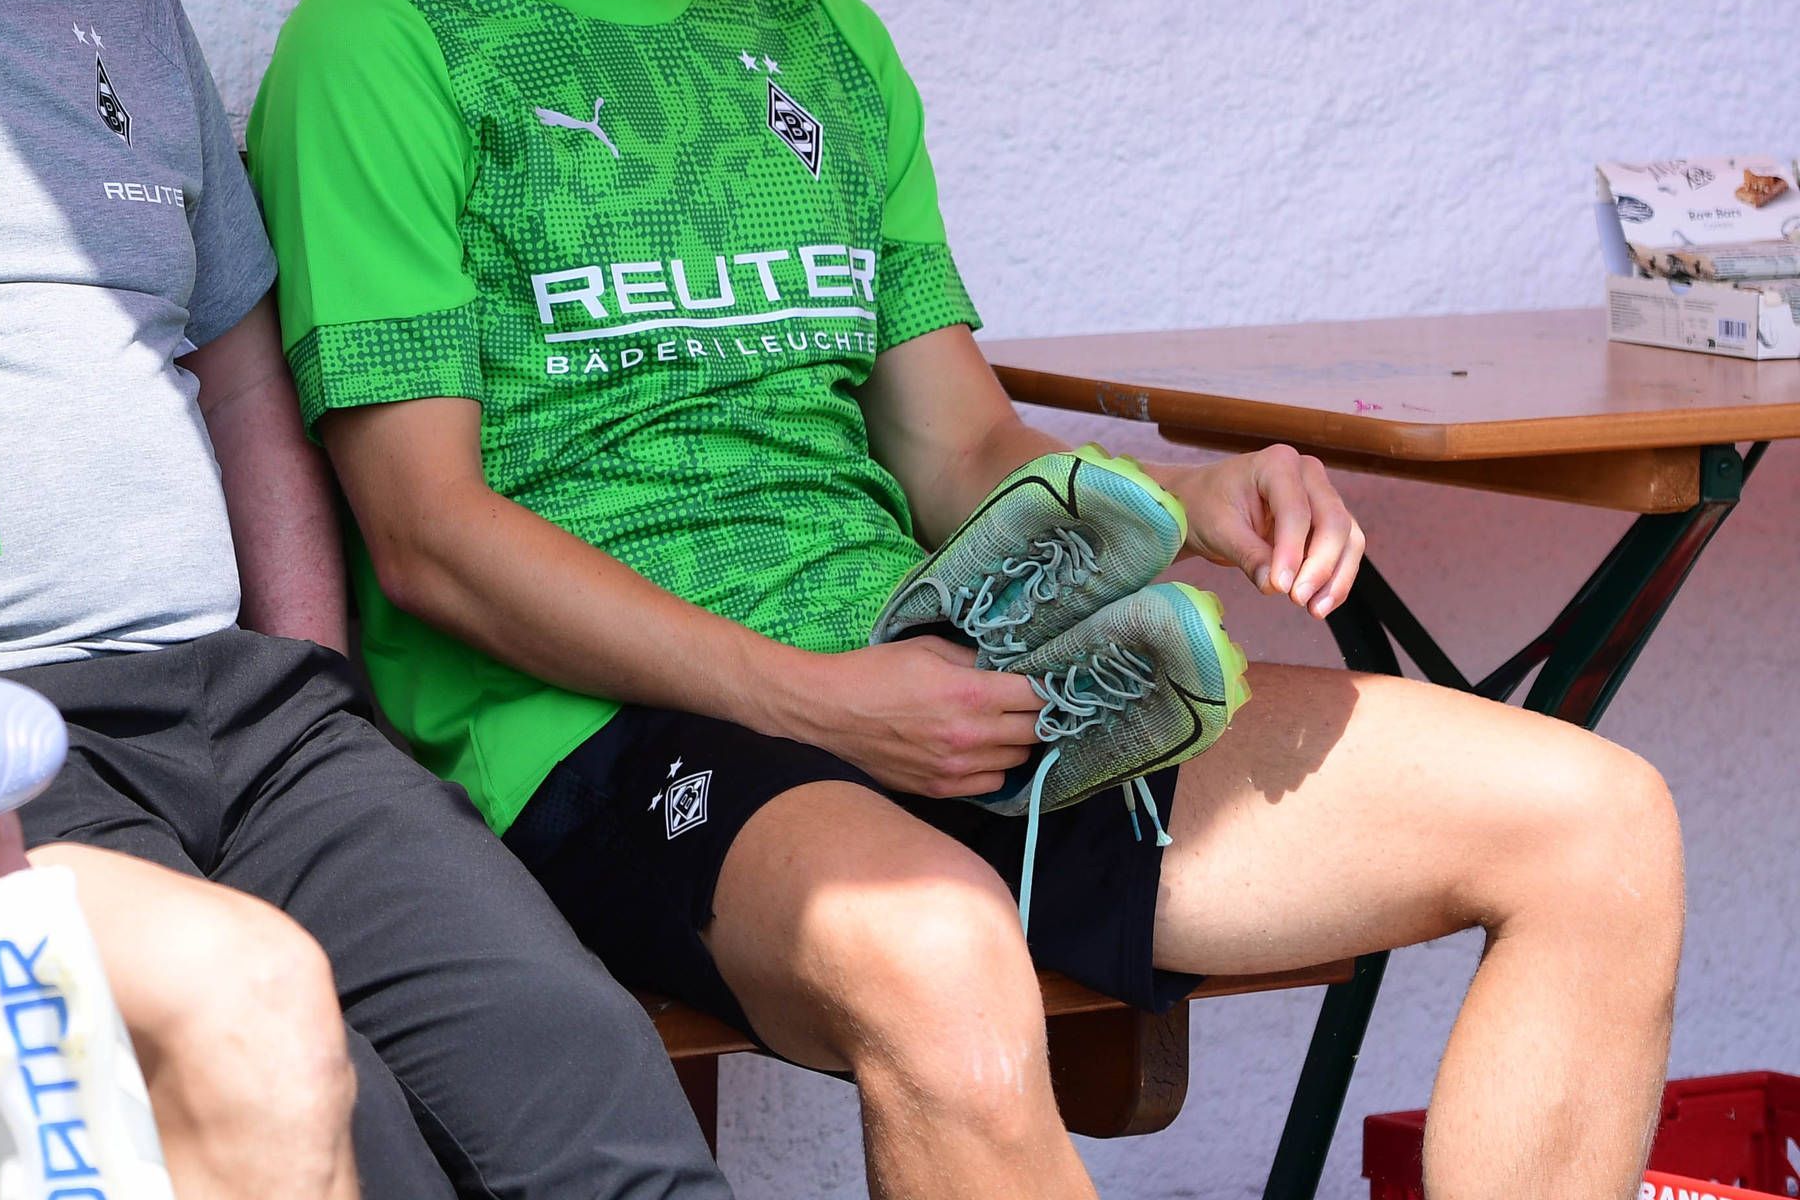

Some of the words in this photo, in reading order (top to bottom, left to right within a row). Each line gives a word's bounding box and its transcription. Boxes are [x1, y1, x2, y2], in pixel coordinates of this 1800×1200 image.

[777, 108, 811, 143] B
[103, 182, 185, 208] REUTE
[531, 244, 877, 324] REUTER
[545, 337, 709, 375] BÄDER
